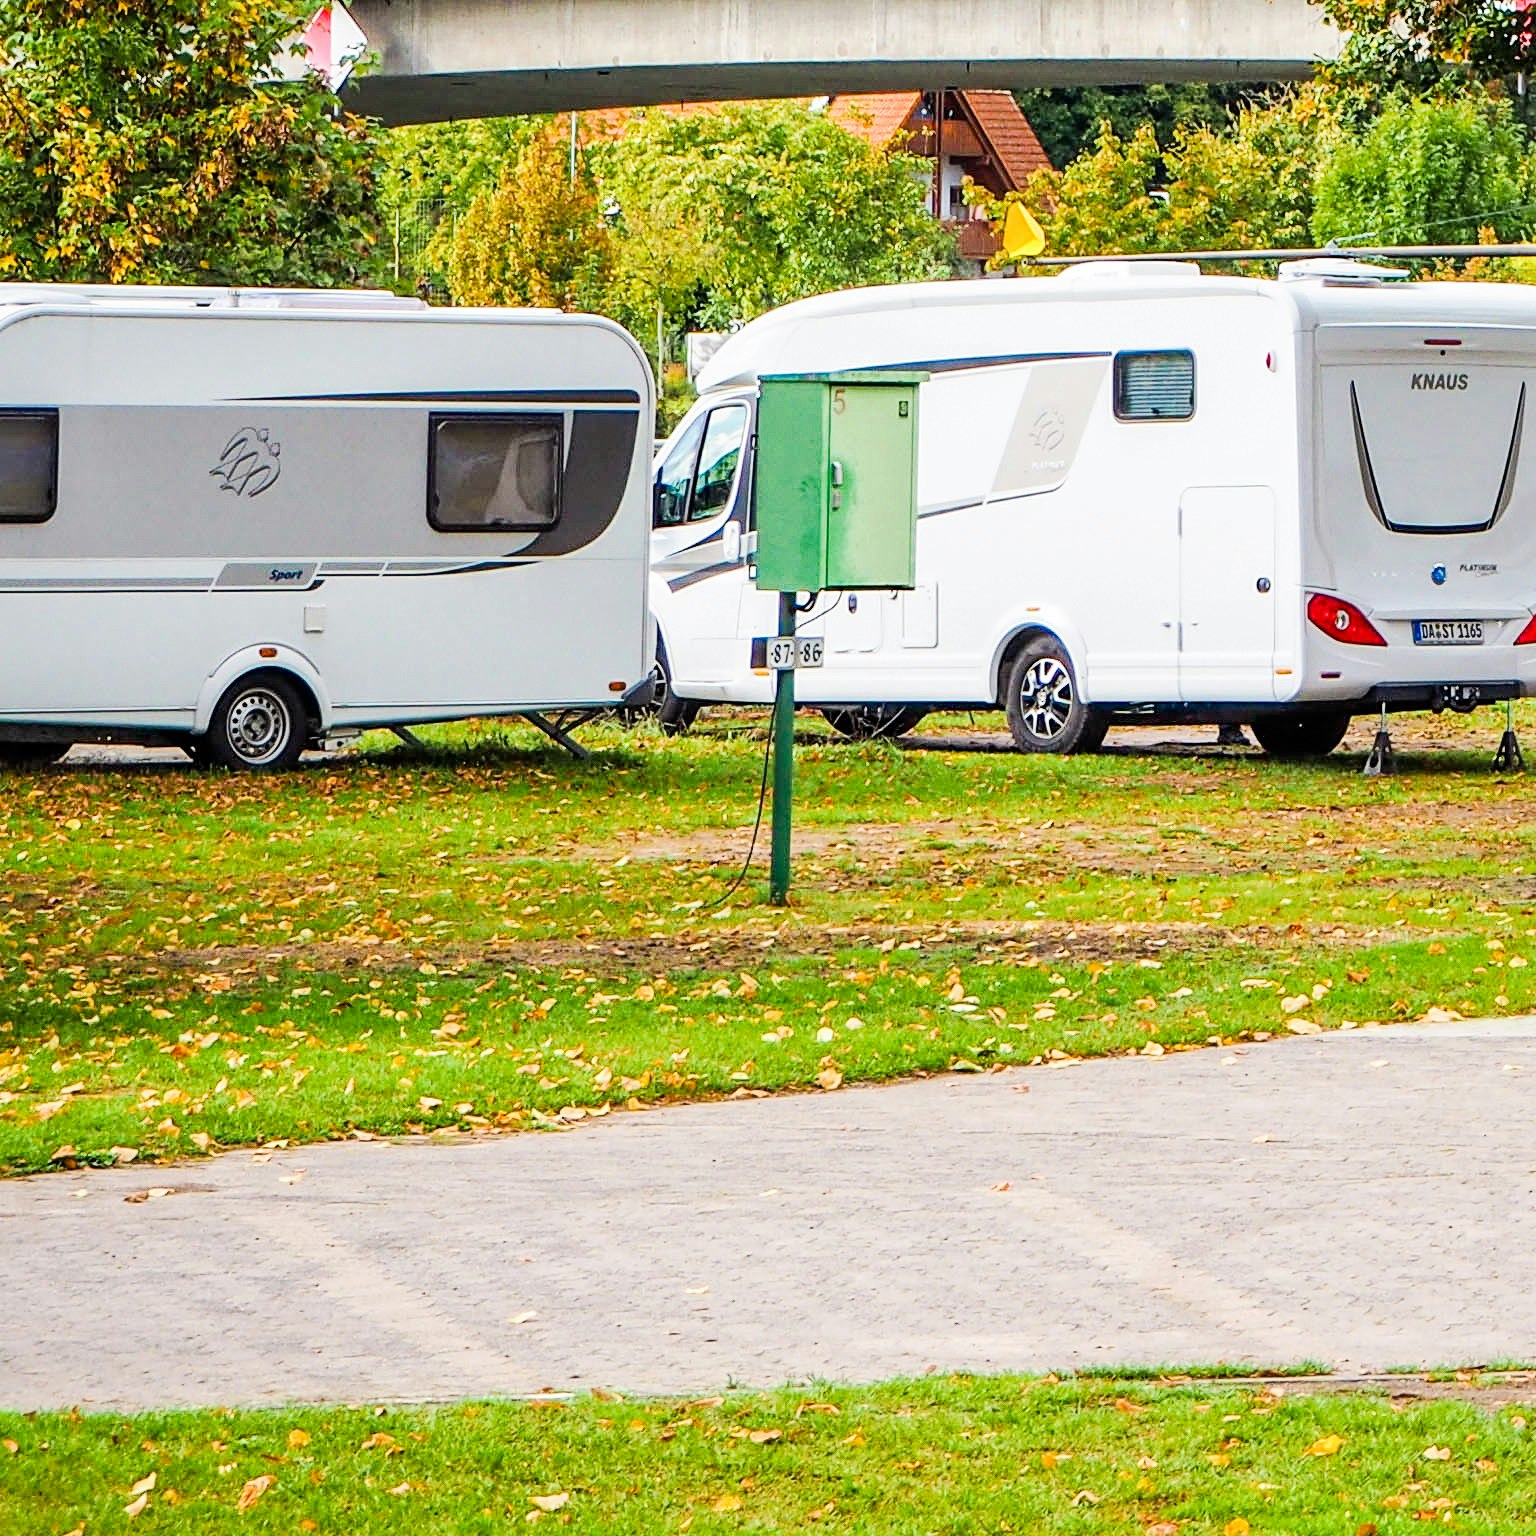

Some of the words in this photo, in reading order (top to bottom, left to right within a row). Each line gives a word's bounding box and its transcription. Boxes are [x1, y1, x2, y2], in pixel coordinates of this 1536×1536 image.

[1411, 373, 1469, 390] KNAUS
[833, 387, 846, 415] 5
[269, 569, 304, 582] Sport
[1421, 623, 1436, 639] DA
[1443, 623, 1455, 639] ST
[1457, 623, 1482, 639] 1165
